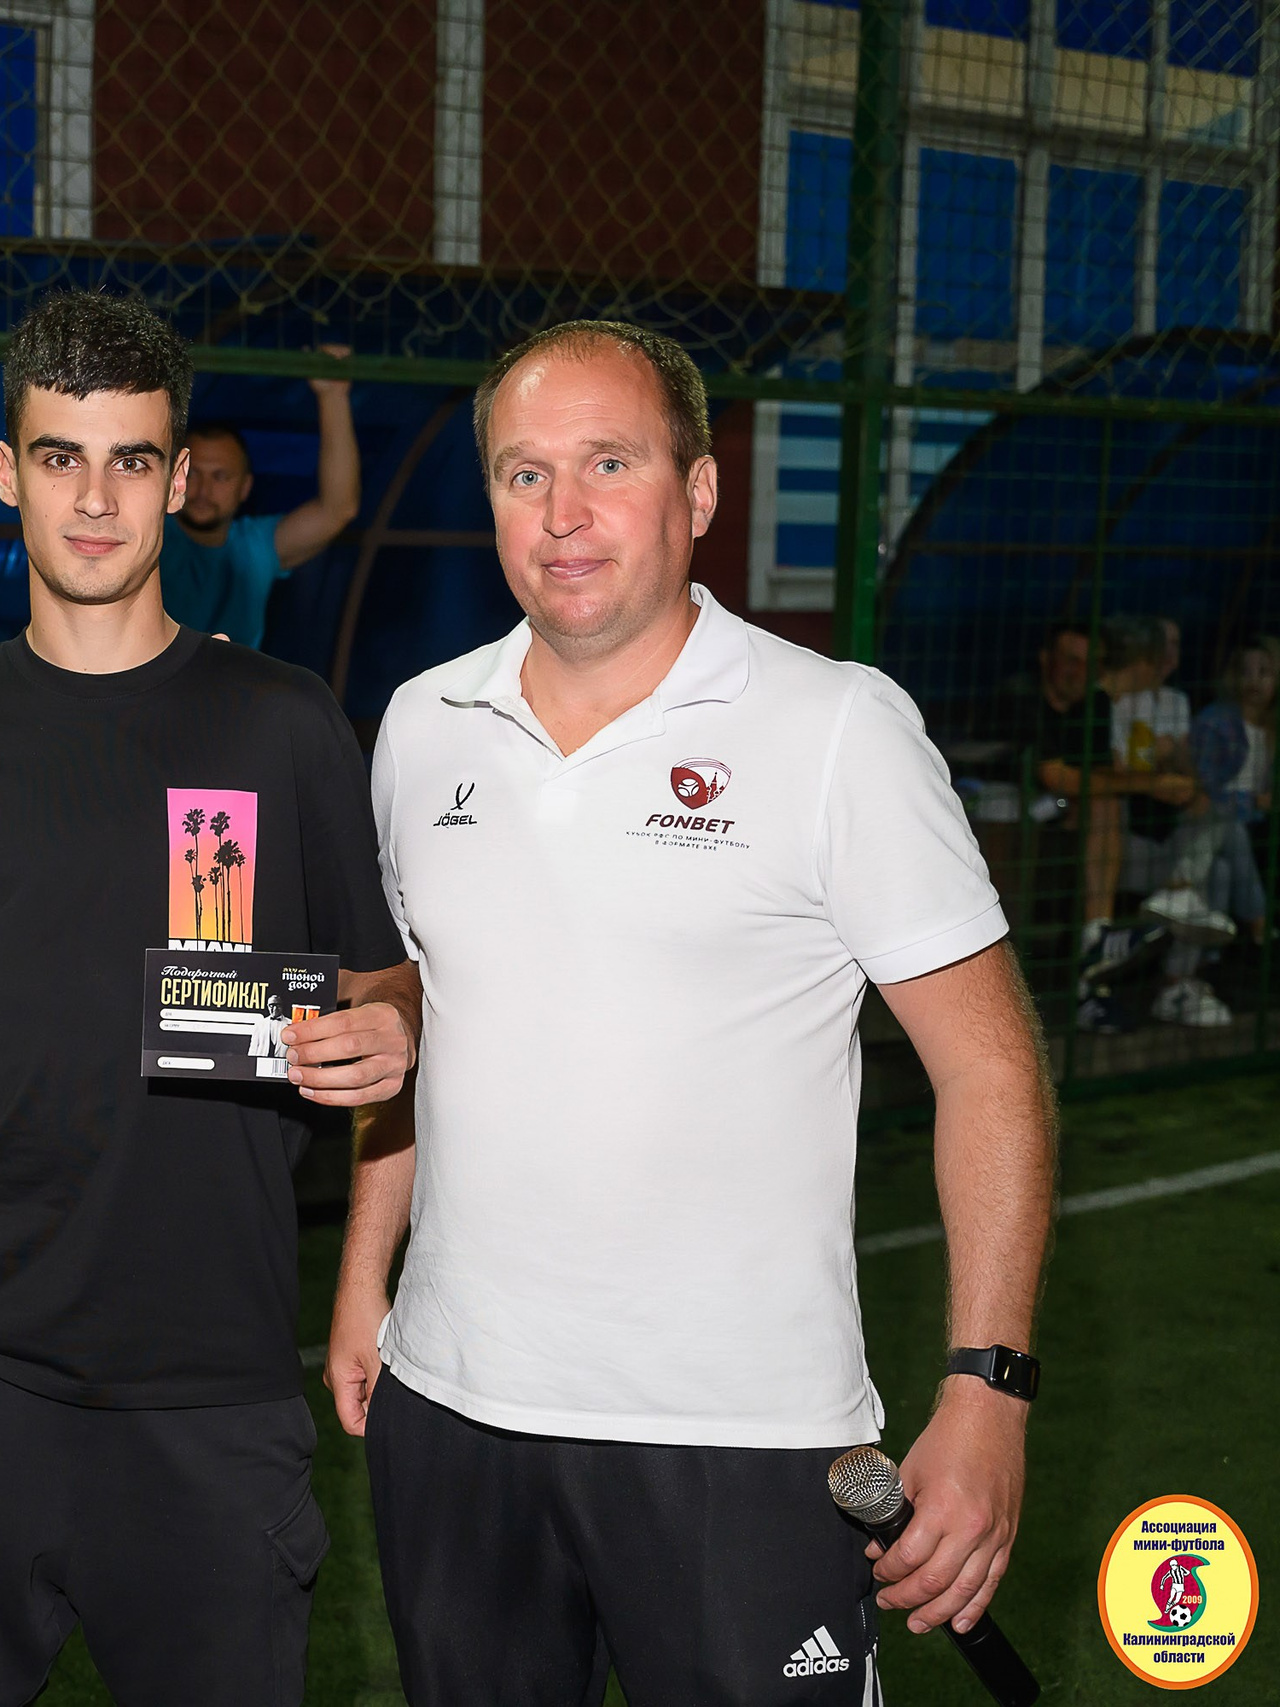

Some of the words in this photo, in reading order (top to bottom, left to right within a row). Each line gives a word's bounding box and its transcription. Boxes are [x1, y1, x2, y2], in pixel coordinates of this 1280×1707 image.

[645, 814, 735, 834] FONBET
[160, 965, 239, 981] Подарочный
[160, 977, 269, 1010] СЕРТИФИКАТ
[783, 1656, 850, 1678] adidas
